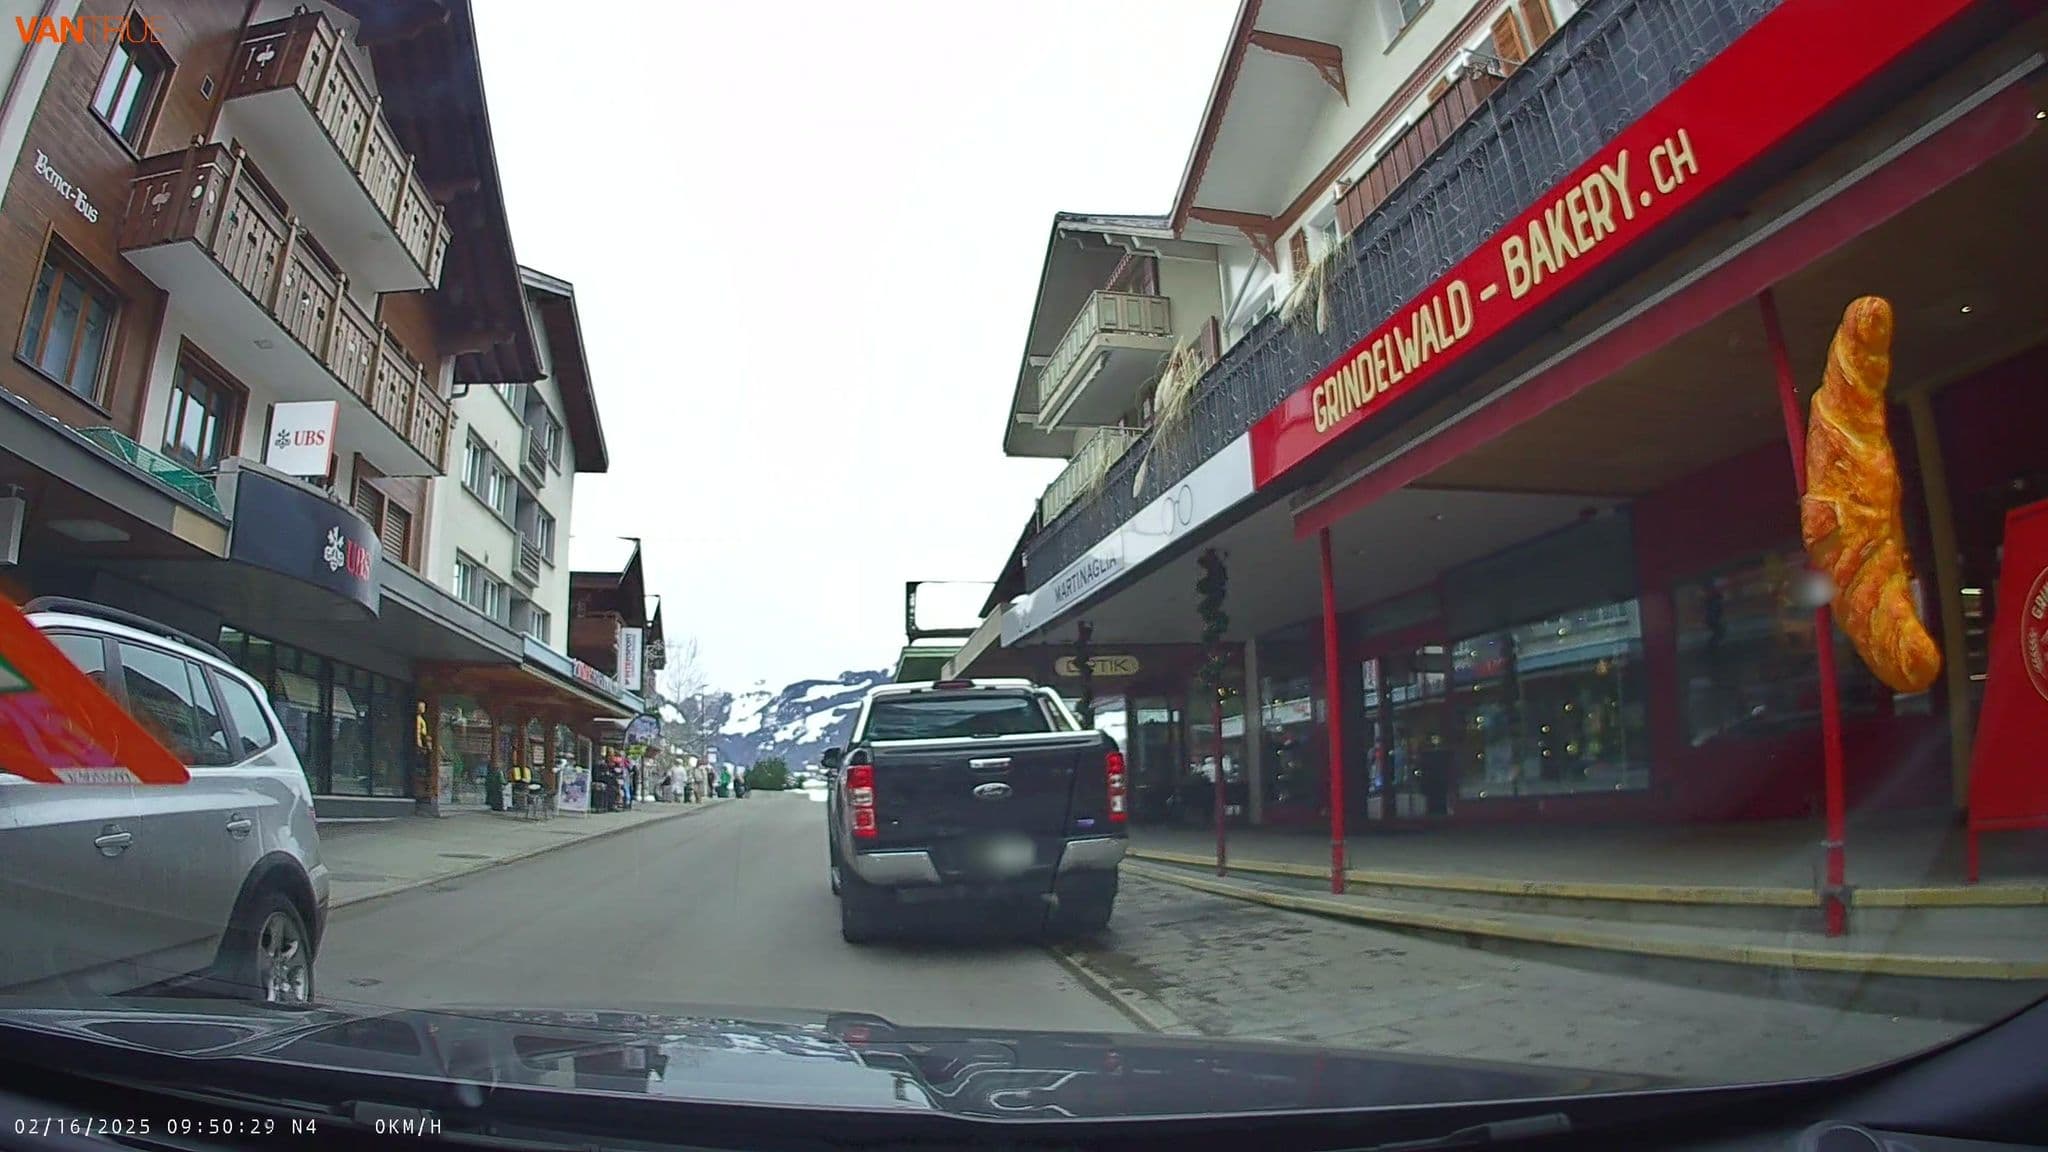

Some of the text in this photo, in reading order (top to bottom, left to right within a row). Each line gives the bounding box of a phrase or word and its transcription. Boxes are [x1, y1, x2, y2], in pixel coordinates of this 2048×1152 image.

[1311, 279, 1474, 433] GRINDELWALD
[1501, 128, 1699, 299] BAKERY.CH
[293, 430, 326, 447] UBS
[346, 539, 372, 581] UBS
[1054, 555, 1118, 600] MARTINAGLIA
